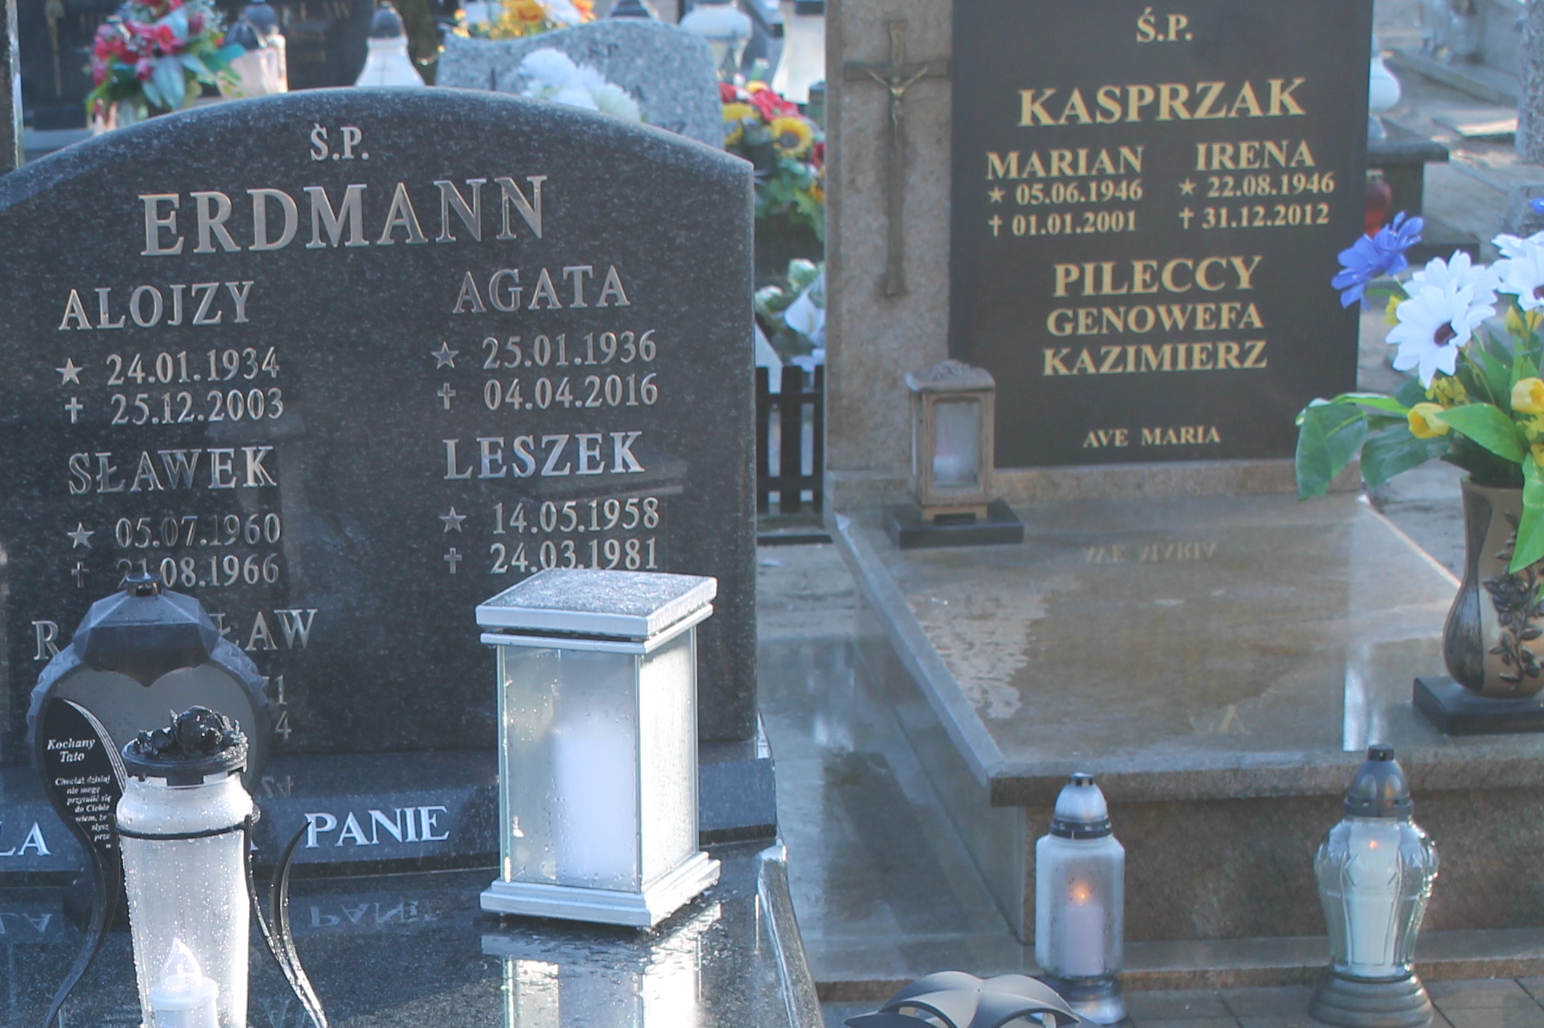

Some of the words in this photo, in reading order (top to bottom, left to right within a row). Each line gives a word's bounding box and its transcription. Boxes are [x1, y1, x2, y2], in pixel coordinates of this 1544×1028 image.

[1135, 6, 1193, 43] Ś.P.
[1016, 77, 1306, 127] KASPRZAK
[309, 122, 369, 161] Ś.P.
[986, 145, 1144, 180] MARIAN
[1195, 139, 1316, 171] IRENA
[1015, 178, 1143, 206] 05.06.1946
[1207, 171, 1336, 198] 22.08.1946
[138, 174, 547, 256] ERDMANN
[1011, 210, 1138, 237] 01.01.2001
[1201, 203, 1330, 230] 31.12.2012
[1053, 255, 1263, 297] PILECCY
[58, 279, 256, 331] ALOJZY
[453, 264, 631, 315] AGATA
[1045, 303, 1264, 337] GENOWEFA
[105, 346, 280, 387] 24.01.1934
[481, 331, 657, 370] 25.01.1936
[1041, 340, 1268, 377] KAZIMIERZ
[110, 386, 285, 424] 25.12.2003
[482, 373, 659, 412] 04.04.2016
[1082, 429, 1129, 449] AVE
[1140, 426, 1221, 447] MARIA
[68, 445, 277, 495] SŁAWEK
[442, 430, 646, 481] LESZEK
[115, 513, 282, 549] 05.07.1960
[492, 497, 659, 534] 14.05.1958
[116, 553, 279, 588] 2108.1966
[490, 537, 658, 574] 24.03.1981
[47, 738, 96, 750] Kochany
[59, 751, 85, 762] Tato
[303, 806, 450, 849] PANIE
